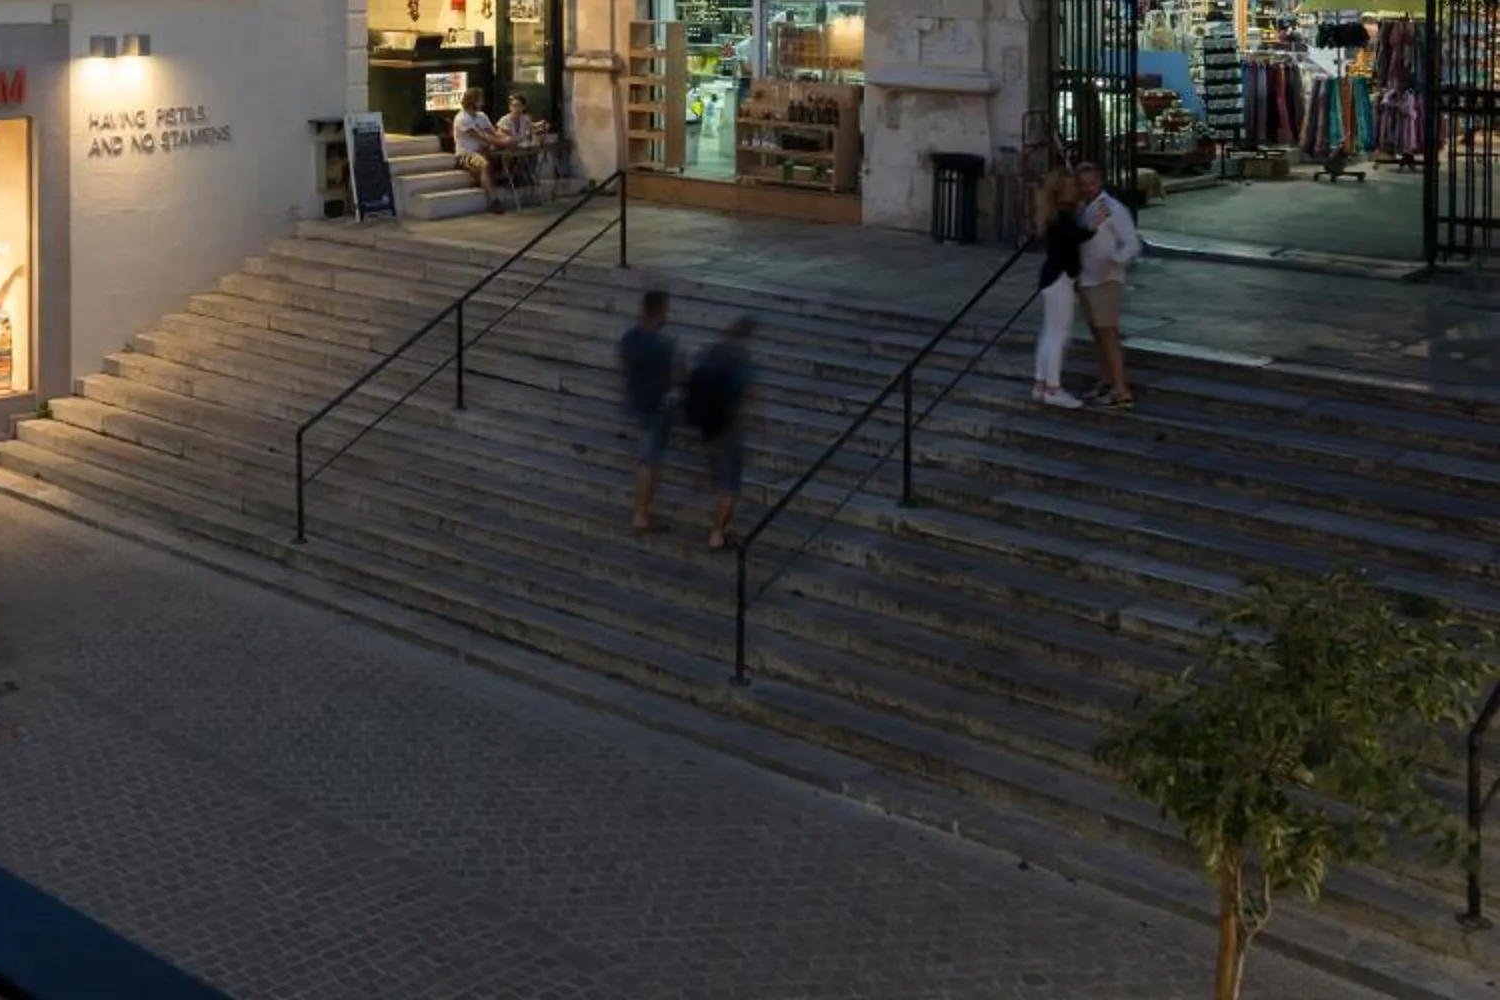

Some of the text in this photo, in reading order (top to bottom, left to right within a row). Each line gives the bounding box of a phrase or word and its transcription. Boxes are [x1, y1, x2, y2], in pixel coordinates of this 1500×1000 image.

[88, 110, 147, 130] HAVING
[88, 125, 231, 158] AND NO STAMENS
